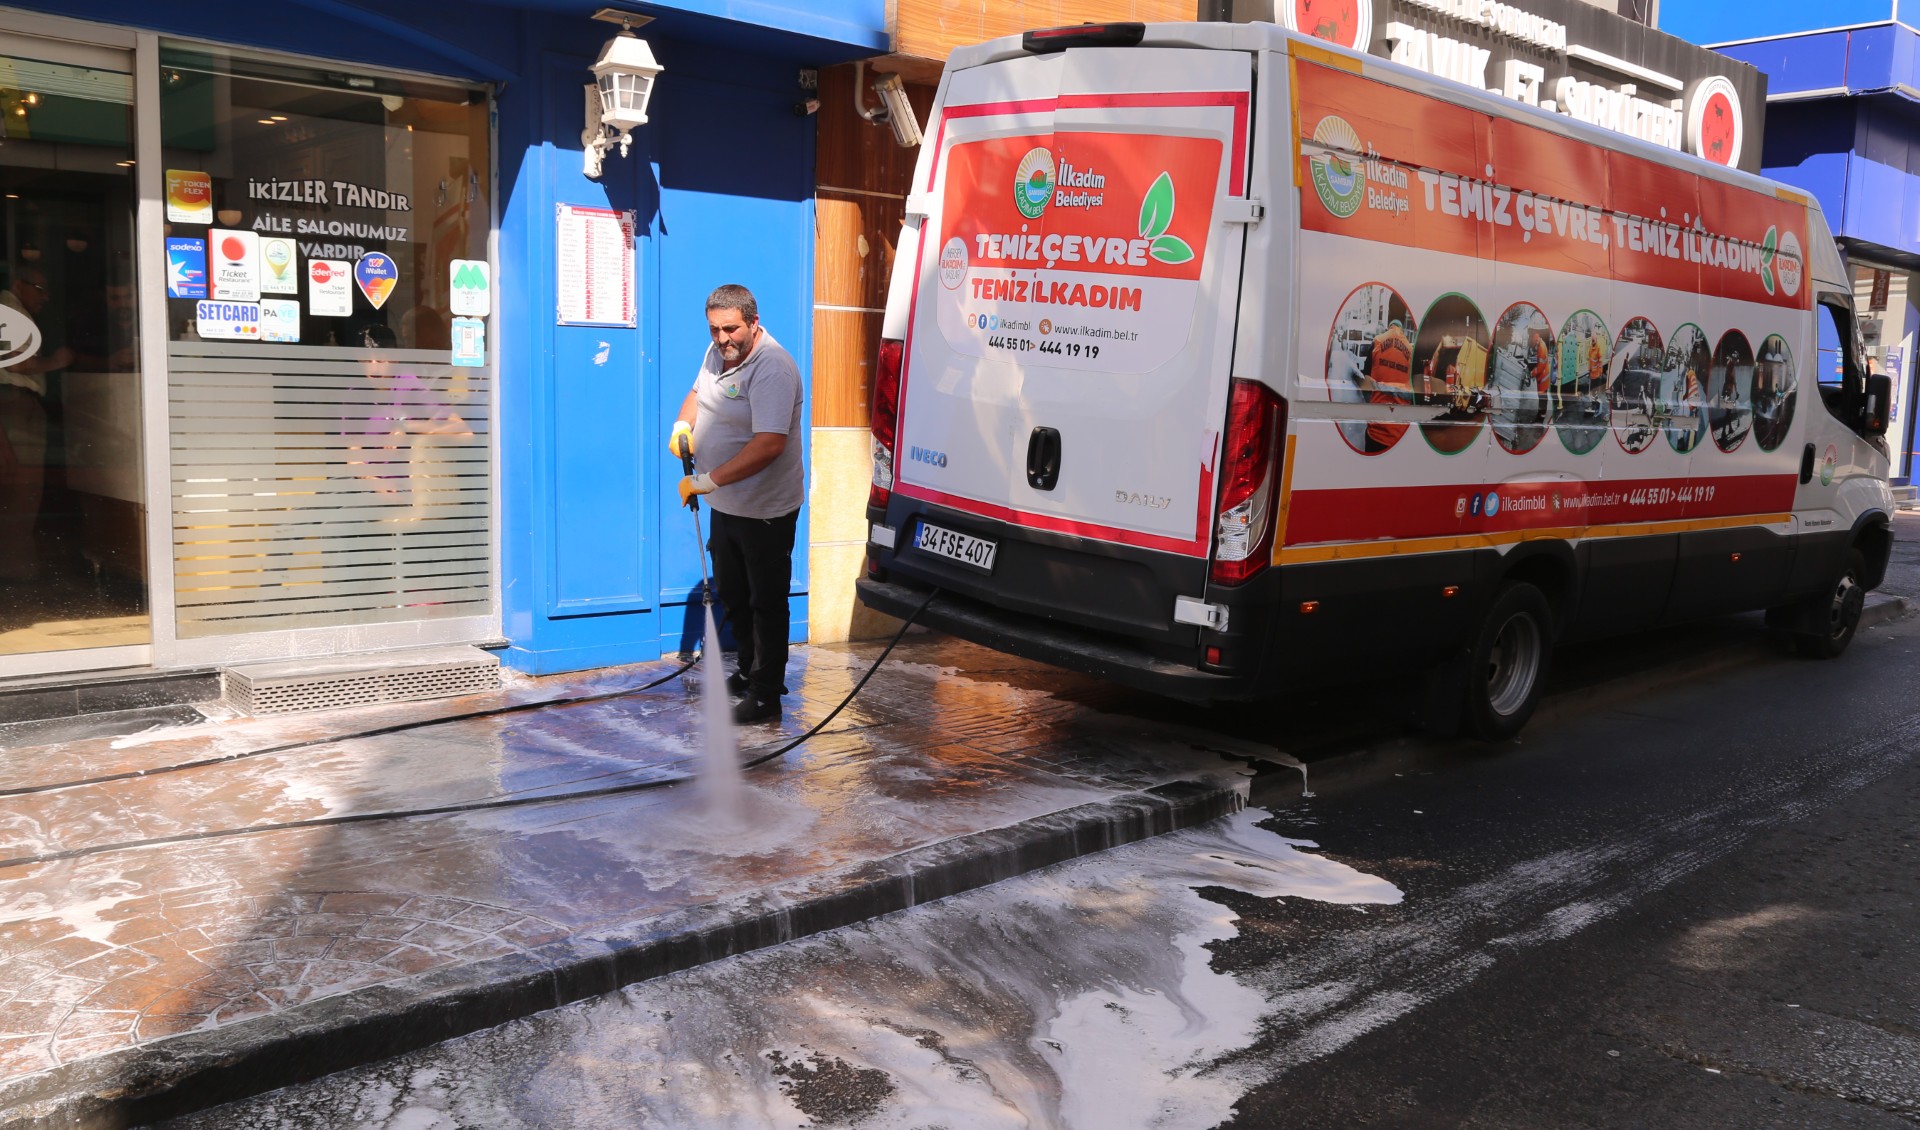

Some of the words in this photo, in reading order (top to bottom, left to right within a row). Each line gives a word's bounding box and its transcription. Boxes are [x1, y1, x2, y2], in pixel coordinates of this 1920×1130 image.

[184, 180, 210, 189] TOKEN
[1057, 157, 1105, 189] İlkadım
[249, 177, 329, 204] İKİZLER
[332, 181, 410, 212] TANDIR
[1055, 190, 1104, 210] Belediyesi
[1367, 187, 1409, 216] Belediyesi
[252, 213, 292, 233] AİLE
[297, 218, 408, 242] SALONUMUZ
[1418, 163, 1512, 226] TEMİZ
[1516, 189, 1610, 251] ÇEVRE,
[1612, 206, 1681, 259] TEMİZ
[1683, 212, 1762, 276] İLKADIM
[170, 242, 203, 252] sodexo
[298, 242, 365, 261] VARDIR
[975, 223, 1040, 261] TEMİZ
[1042, 234, 1150, 268] ÇEVRE
[221, 269, 248, 278] Ticket
[311, 267, 345, 277] Edenred
[365, 267, 387, 275] iWallet
[971, 270, 1029, 303] TEMİZ
[1031, 272, 1143, 312] İLKADIM
[198, 302, 259, 322] SETCARD
[1054, 324, 1138, 342] www.ilkadim.bel.tr
[988, 335, 1005, 350] 444
[1006, 337, 1018, 351] 55
[1019, 339, 1030, 352] 01
[1039, 341, 1062, 355] 444
[1066, 343, 1081, 357] 19
[1084, 345, 1100, 359] 19
[910, 445, 948, 468] IVECO
[1115, 489, 1172, 510] DAILY
[1502, 495, 1546, 512] ilkadimbld
[1563, 492, 1621, 509] www.ilkadim.bel.tr
[1629, 488, 1647, 505] 444
[1647, 488, 1659, 505] 55
[1659, 487, 1670, 504] 01
[1677, 486, 1693, 503] 444
[1694, 486, 1704, 502] 19
[1705, 485, 1715, 501] 19
[921, 526, 939, 550] 34
[939, 531, 965, 559] FSE
[964, 540, 994, 566] 407
